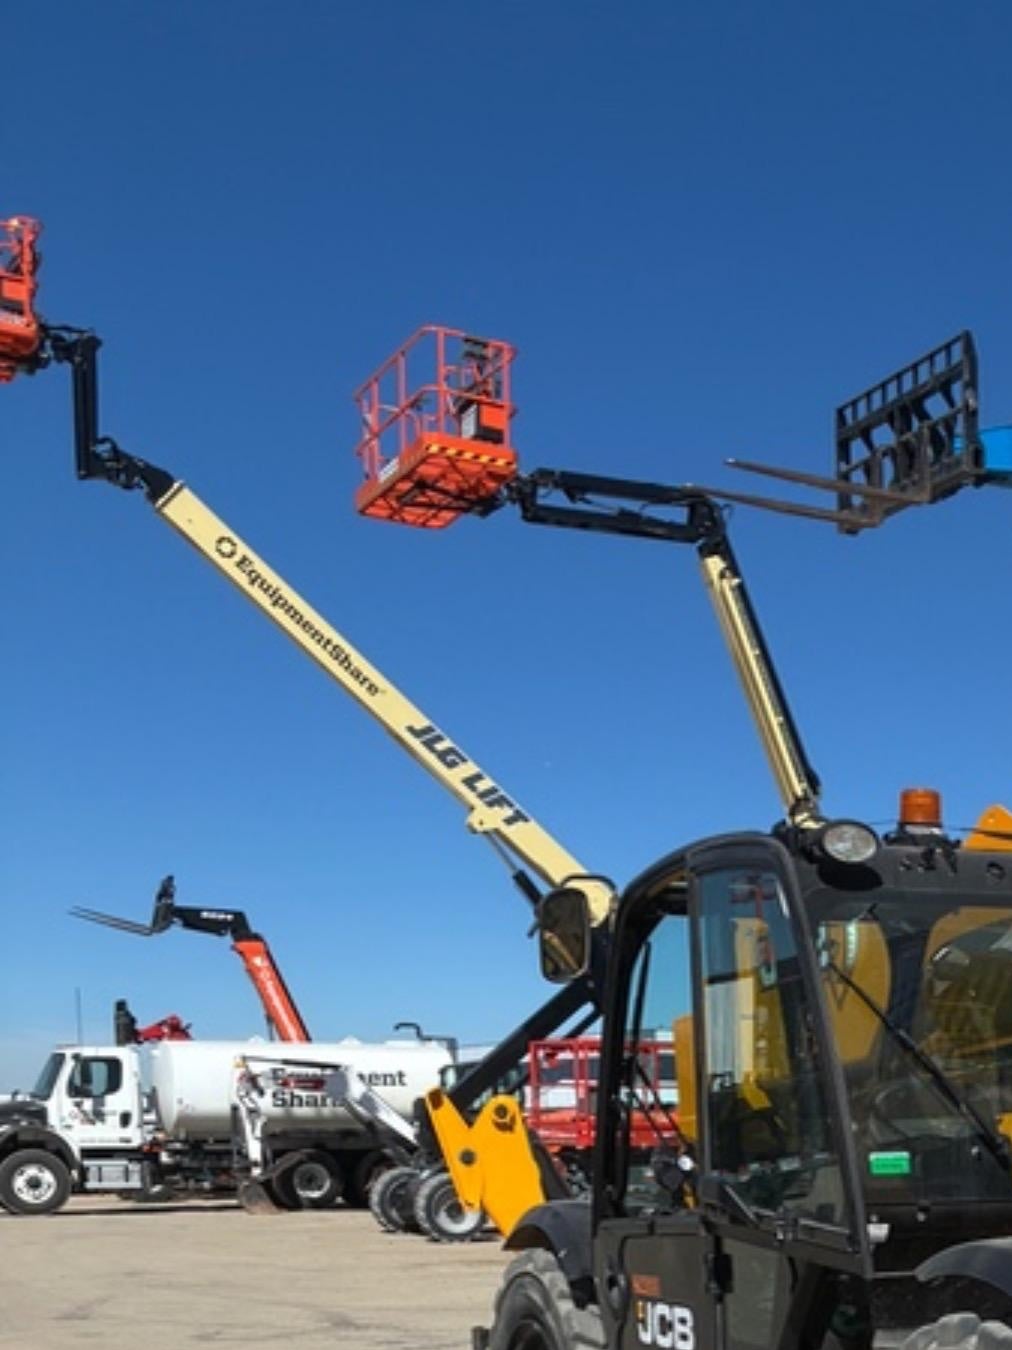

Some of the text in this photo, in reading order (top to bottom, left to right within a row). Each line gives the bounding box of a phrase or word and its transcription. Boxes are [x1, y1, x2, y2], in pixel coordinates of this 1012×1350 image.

[235, 554, 380, 697] EquipmentShare
[405, 724, 530, 826] JLG LIFT
